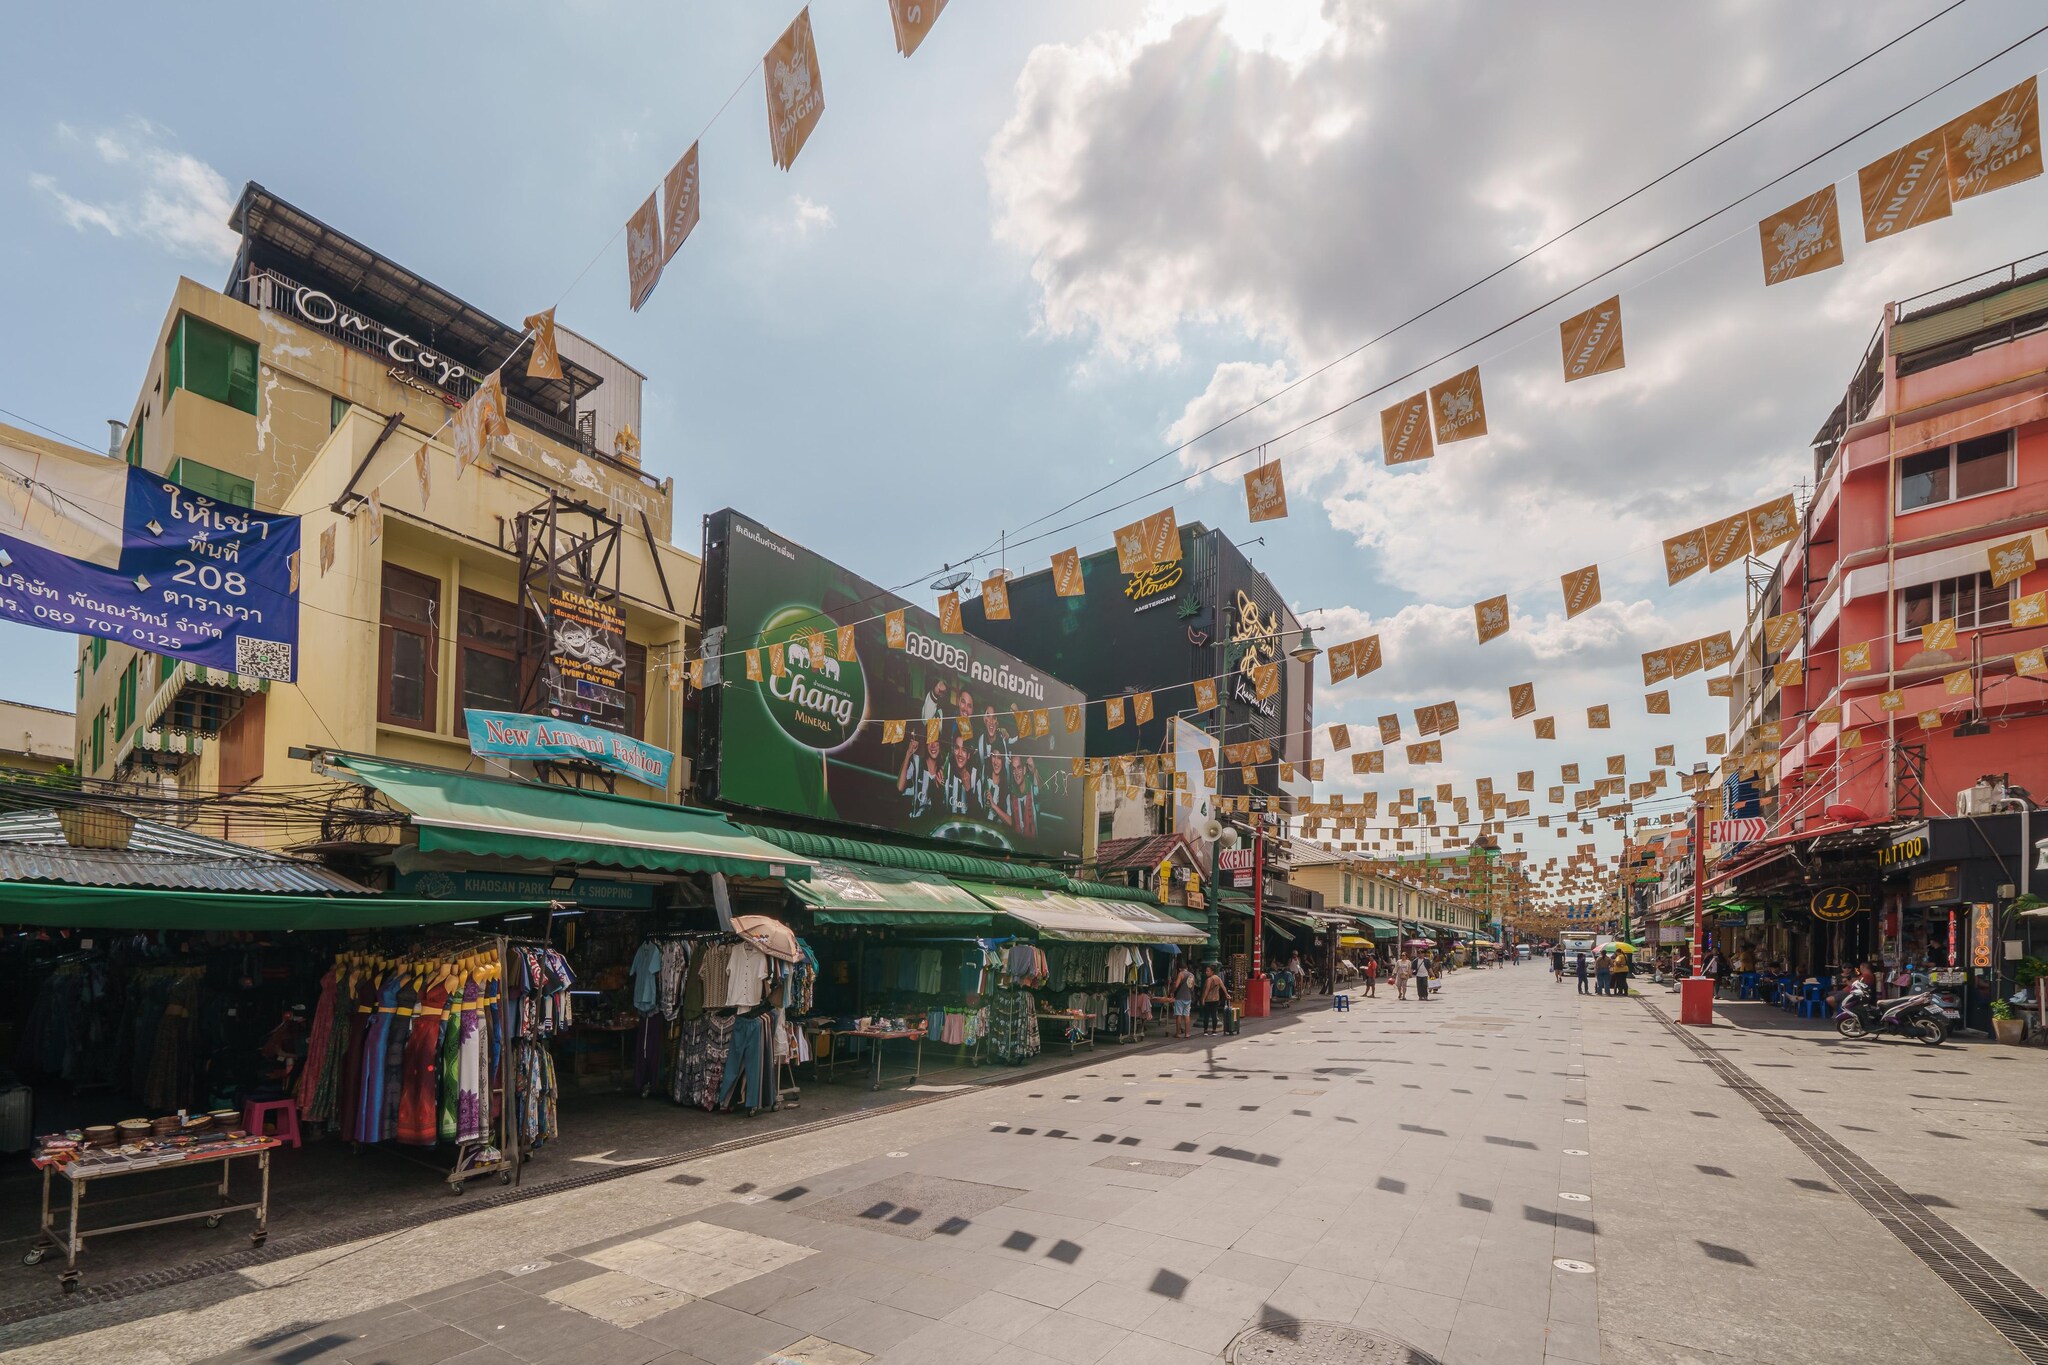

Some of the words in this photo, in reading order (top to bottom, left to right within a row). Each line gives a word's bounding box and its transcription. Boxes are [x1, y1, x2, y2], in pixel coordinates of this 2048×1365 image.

[780, 91, 821, 138] SINGHA
[1956, 143, 2033, 189] SINGHA
[669, 162, 696, 246] SINGHA
[1876, 146, 1935, 233] SINGHA
[1770, 238, 1834, 276] SINGHA
[382, 327, 466, 386] Top
[1572, 310, 1615, 375] SINGHA
[387, 367, 436, 396] Khao
[1393, 403, 1423, 460] SINGHA
[1439, 410, 1481, 436] SINGHA
[162, 483, 269, 540] ให้เช่า
[1250, 496, 1283, 515] SINGHA
[187, 530, 241, 564] พื้นที่
[1154, 516, 1171, 560] SINGHA
[1714, 520, 1744, 563] SINGHA
[1755, 526, 1796, 544] SINGHA
[1060, 555, 1076, 593] SINGHA
[1122, 552, 1148, 570] SINGHA
[1670, 556, 1706, 573] SINGHA
[1994, 560, 2032, 578] SINGHA
[172, 559, 247, 596] 208
[1570, 570, 1595, 610] SINGHA
[163, 589, 262, 624] ตารางวา
[549, 597, 577, 611] COMEDY
[578, 606, 593, 617] CLUB
[562, 590, 617, 617] KHAOSAN
[943, 598, 957, 631] SINGHA
[986, 602, 1008, 614] SINGHA
[1134, 594, 1176, 614] AMSTERDAM
[2014, 612, 2045, 624] SINGHA
[34, 604, 76, 624] 089
[85, 617, 124, 635] 707
[132, 628, 182, 650] 0125
[176, 617, 223, 640] จำกัด
[1480, 620, 1508, 632] SINGHA
[1770, 616, 1795, 648] SINGHA
[1928, 622, 1951, 649] SINGHA
[554, 656, 581, 669] STAND
[593, 666, 622, 680] COMEDY
[906, 631, 970, 674] คอบอล
[970, 664, 1045, 702] คอเดียวกัน
[1359, 640, 1376, 671] SINGHA
[1676, 644, 1698, 673] SINGHA
[1843, 659, 1868, 670] SINGHA
[561, 667, 586, 679] EVERY
[586, 674, 601, 682] DAY
[602, 678, 616, 688] 9PM
[1259, 668, 1274, 696] SINGHA
[1778, 663, 1798, 686] SINGHA
[770, 667, 854, 727] Chang
[1514, 686, 1530, 710] SINGHA
[794, 710, 832, 732] MINERAL
[484, 719, 530, 746] New
[536, 725, 605, 755] Armani
[611, 738, 663, 777] Fashion
[1710, 820, 1742, 843] EXIT
[1232, 850, 1252, 868] EXIT
[1878, 836, 1922, 866] TATTOO
[464, 878, 516, 893] KHAOSAN
[518, 881, 545, 894] PARK
[579, 886, 586, 896] &
[588, 886, 633, 900] SHOPPING
[1823, 892, 1850, 908] 11
[1974, 904, 1990, 967] TATTOO
